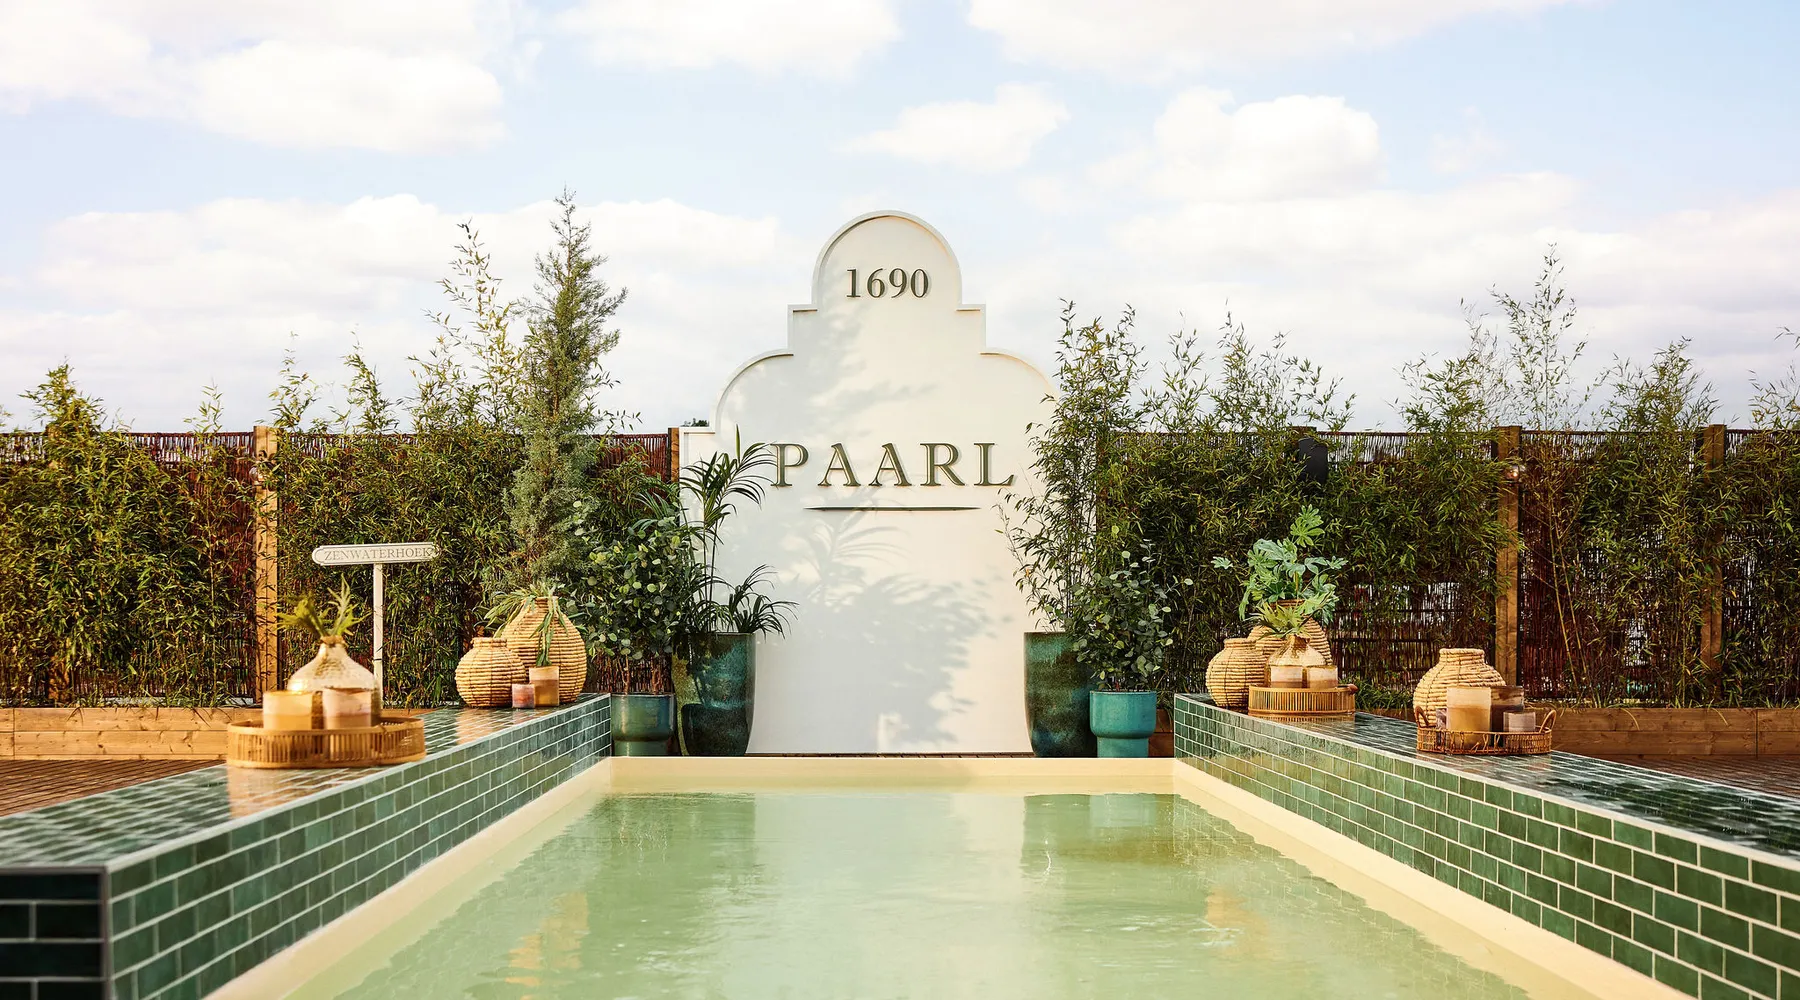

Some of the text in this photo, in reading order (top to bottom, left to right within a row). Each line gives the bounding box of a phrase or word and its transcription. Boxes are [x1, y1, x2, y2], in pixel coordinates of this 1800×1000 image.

[846, 268, 930, 299] 1690
[771, 442, 1015, 488] PAARL
[324, 547, 433, 561] ZENWATERHOEK
